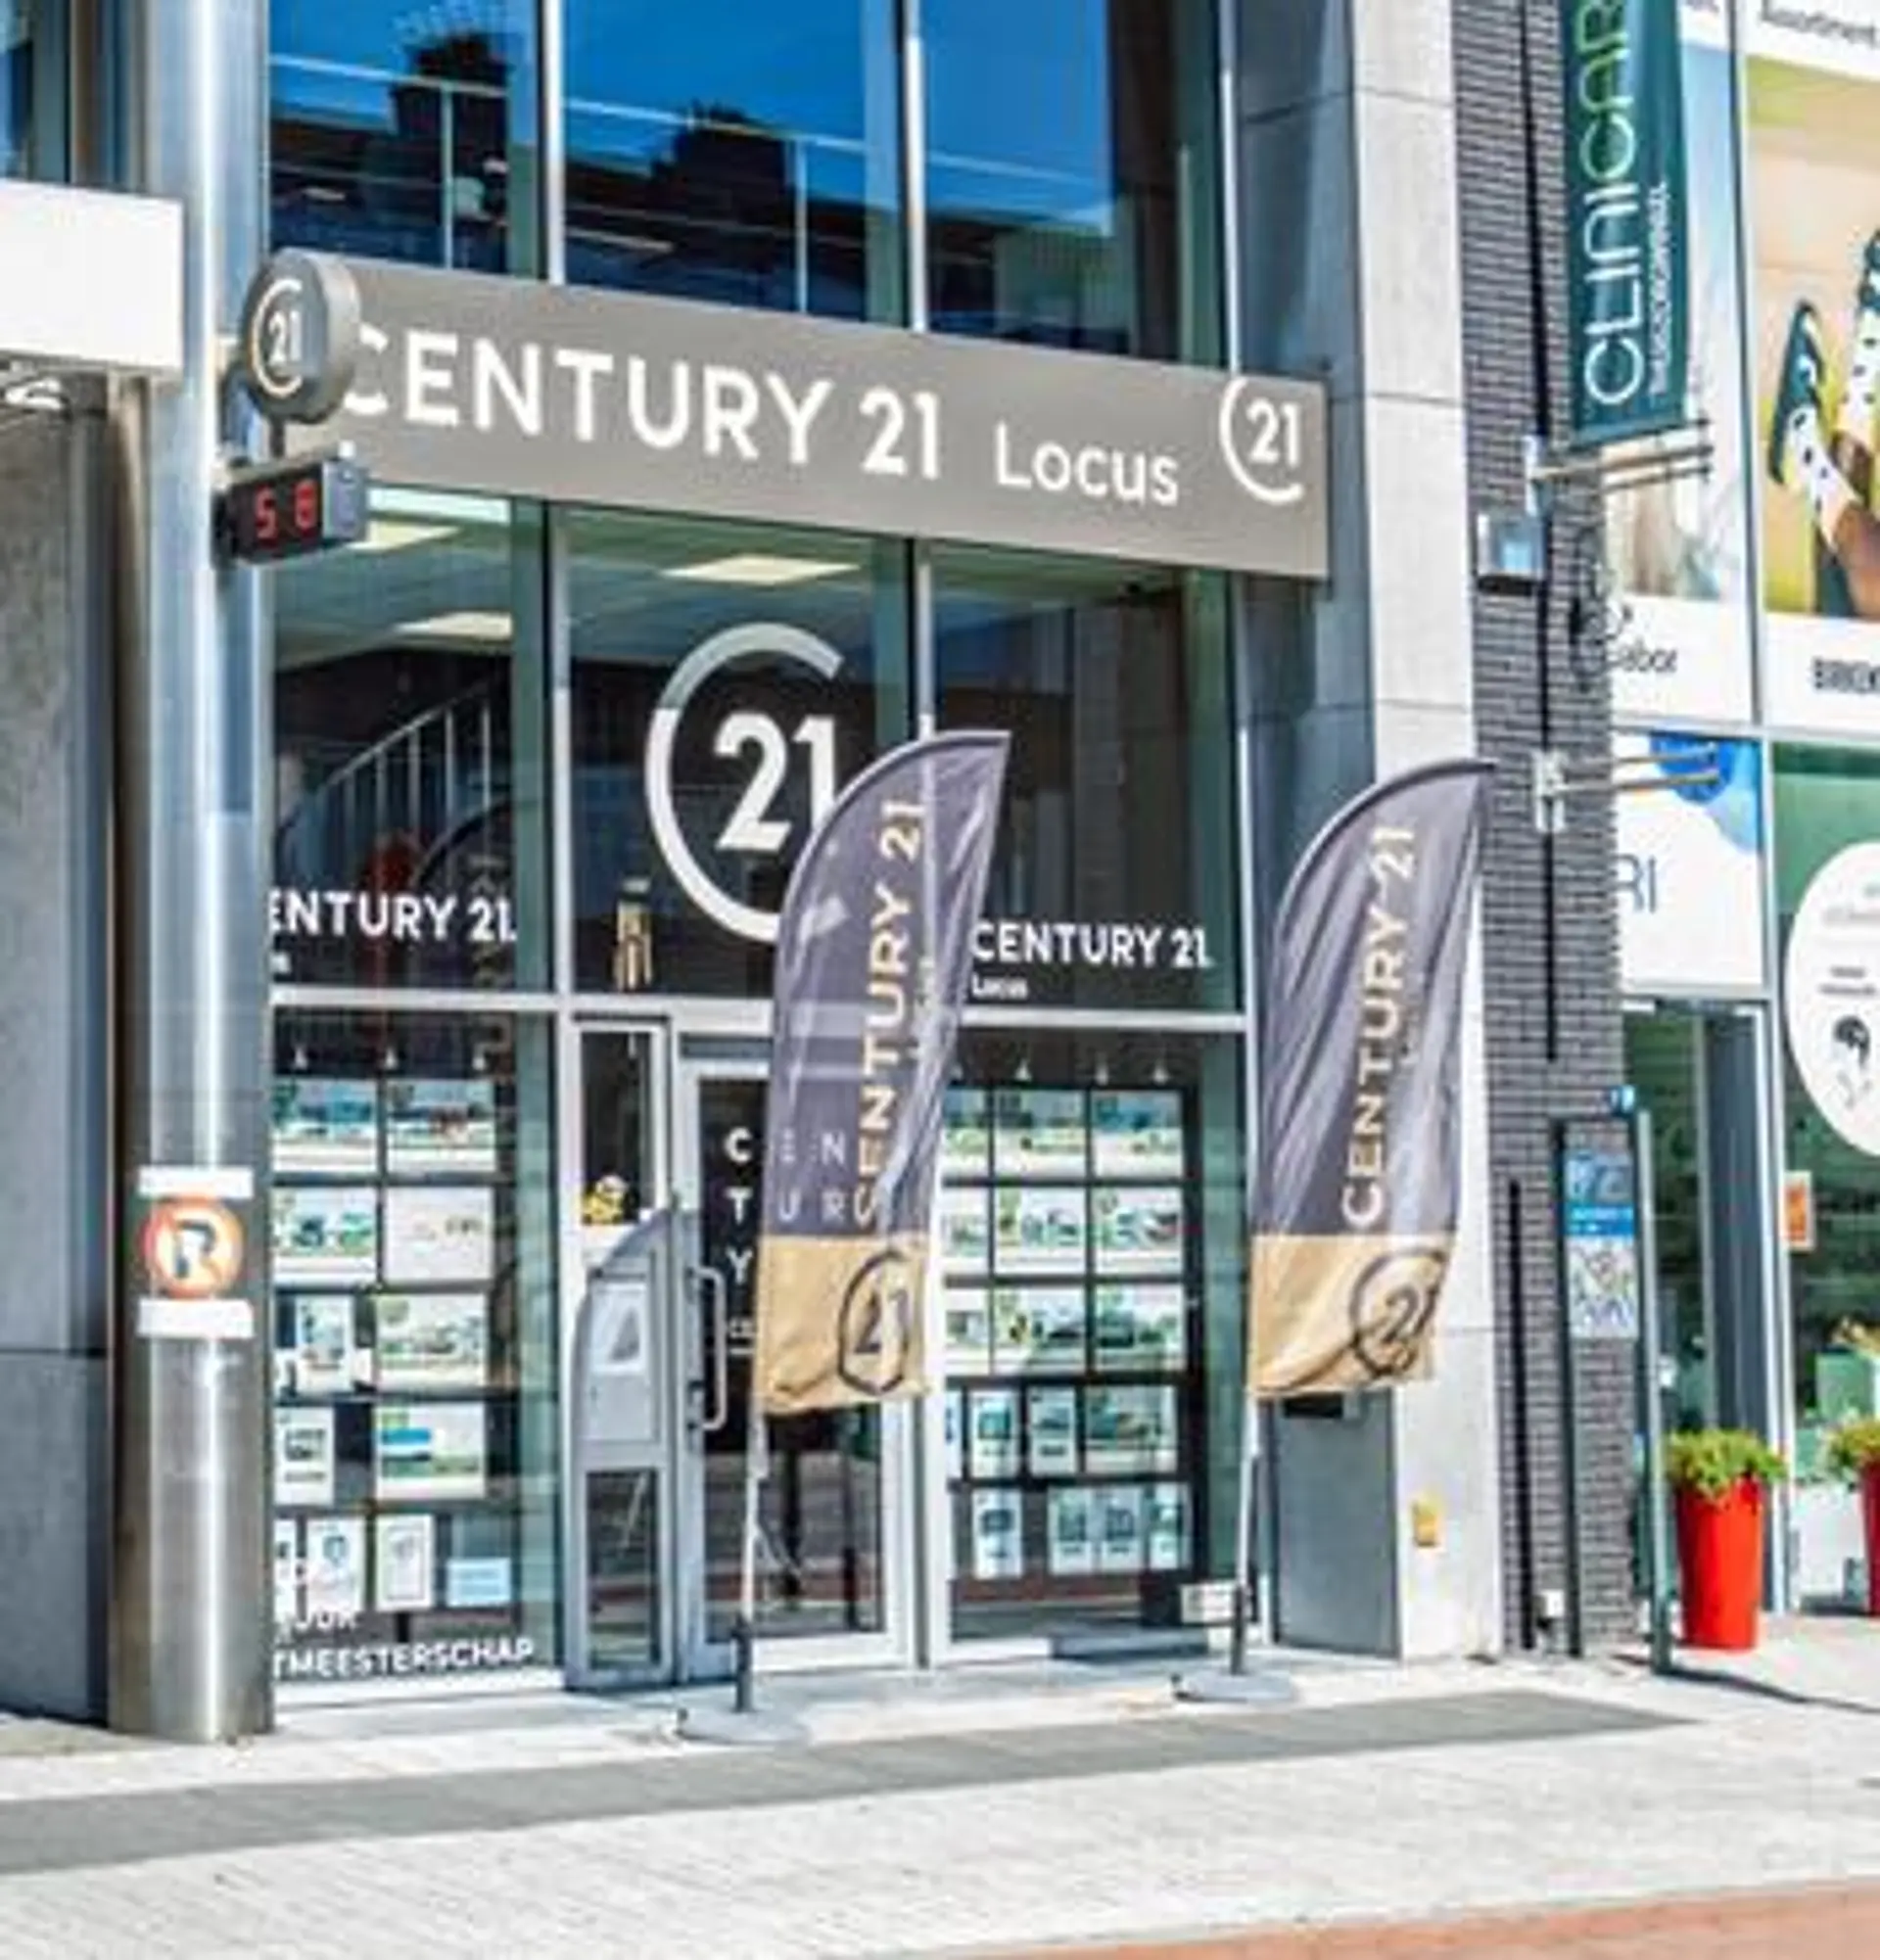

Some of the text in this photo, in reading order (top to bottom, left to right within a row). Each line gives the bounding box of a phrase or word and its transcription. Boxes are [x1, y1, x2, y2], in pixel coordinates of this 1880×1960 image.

[859, 386, 941, 480] 21
[994, 420, 1179, 506] Locus
[879, 800, 926, 863] 21
[1374, 824, 1416, 877] 21
[968, 916, 1163, 968] CENTURY
[1341, 904, 1408, 1228] CENTURY
